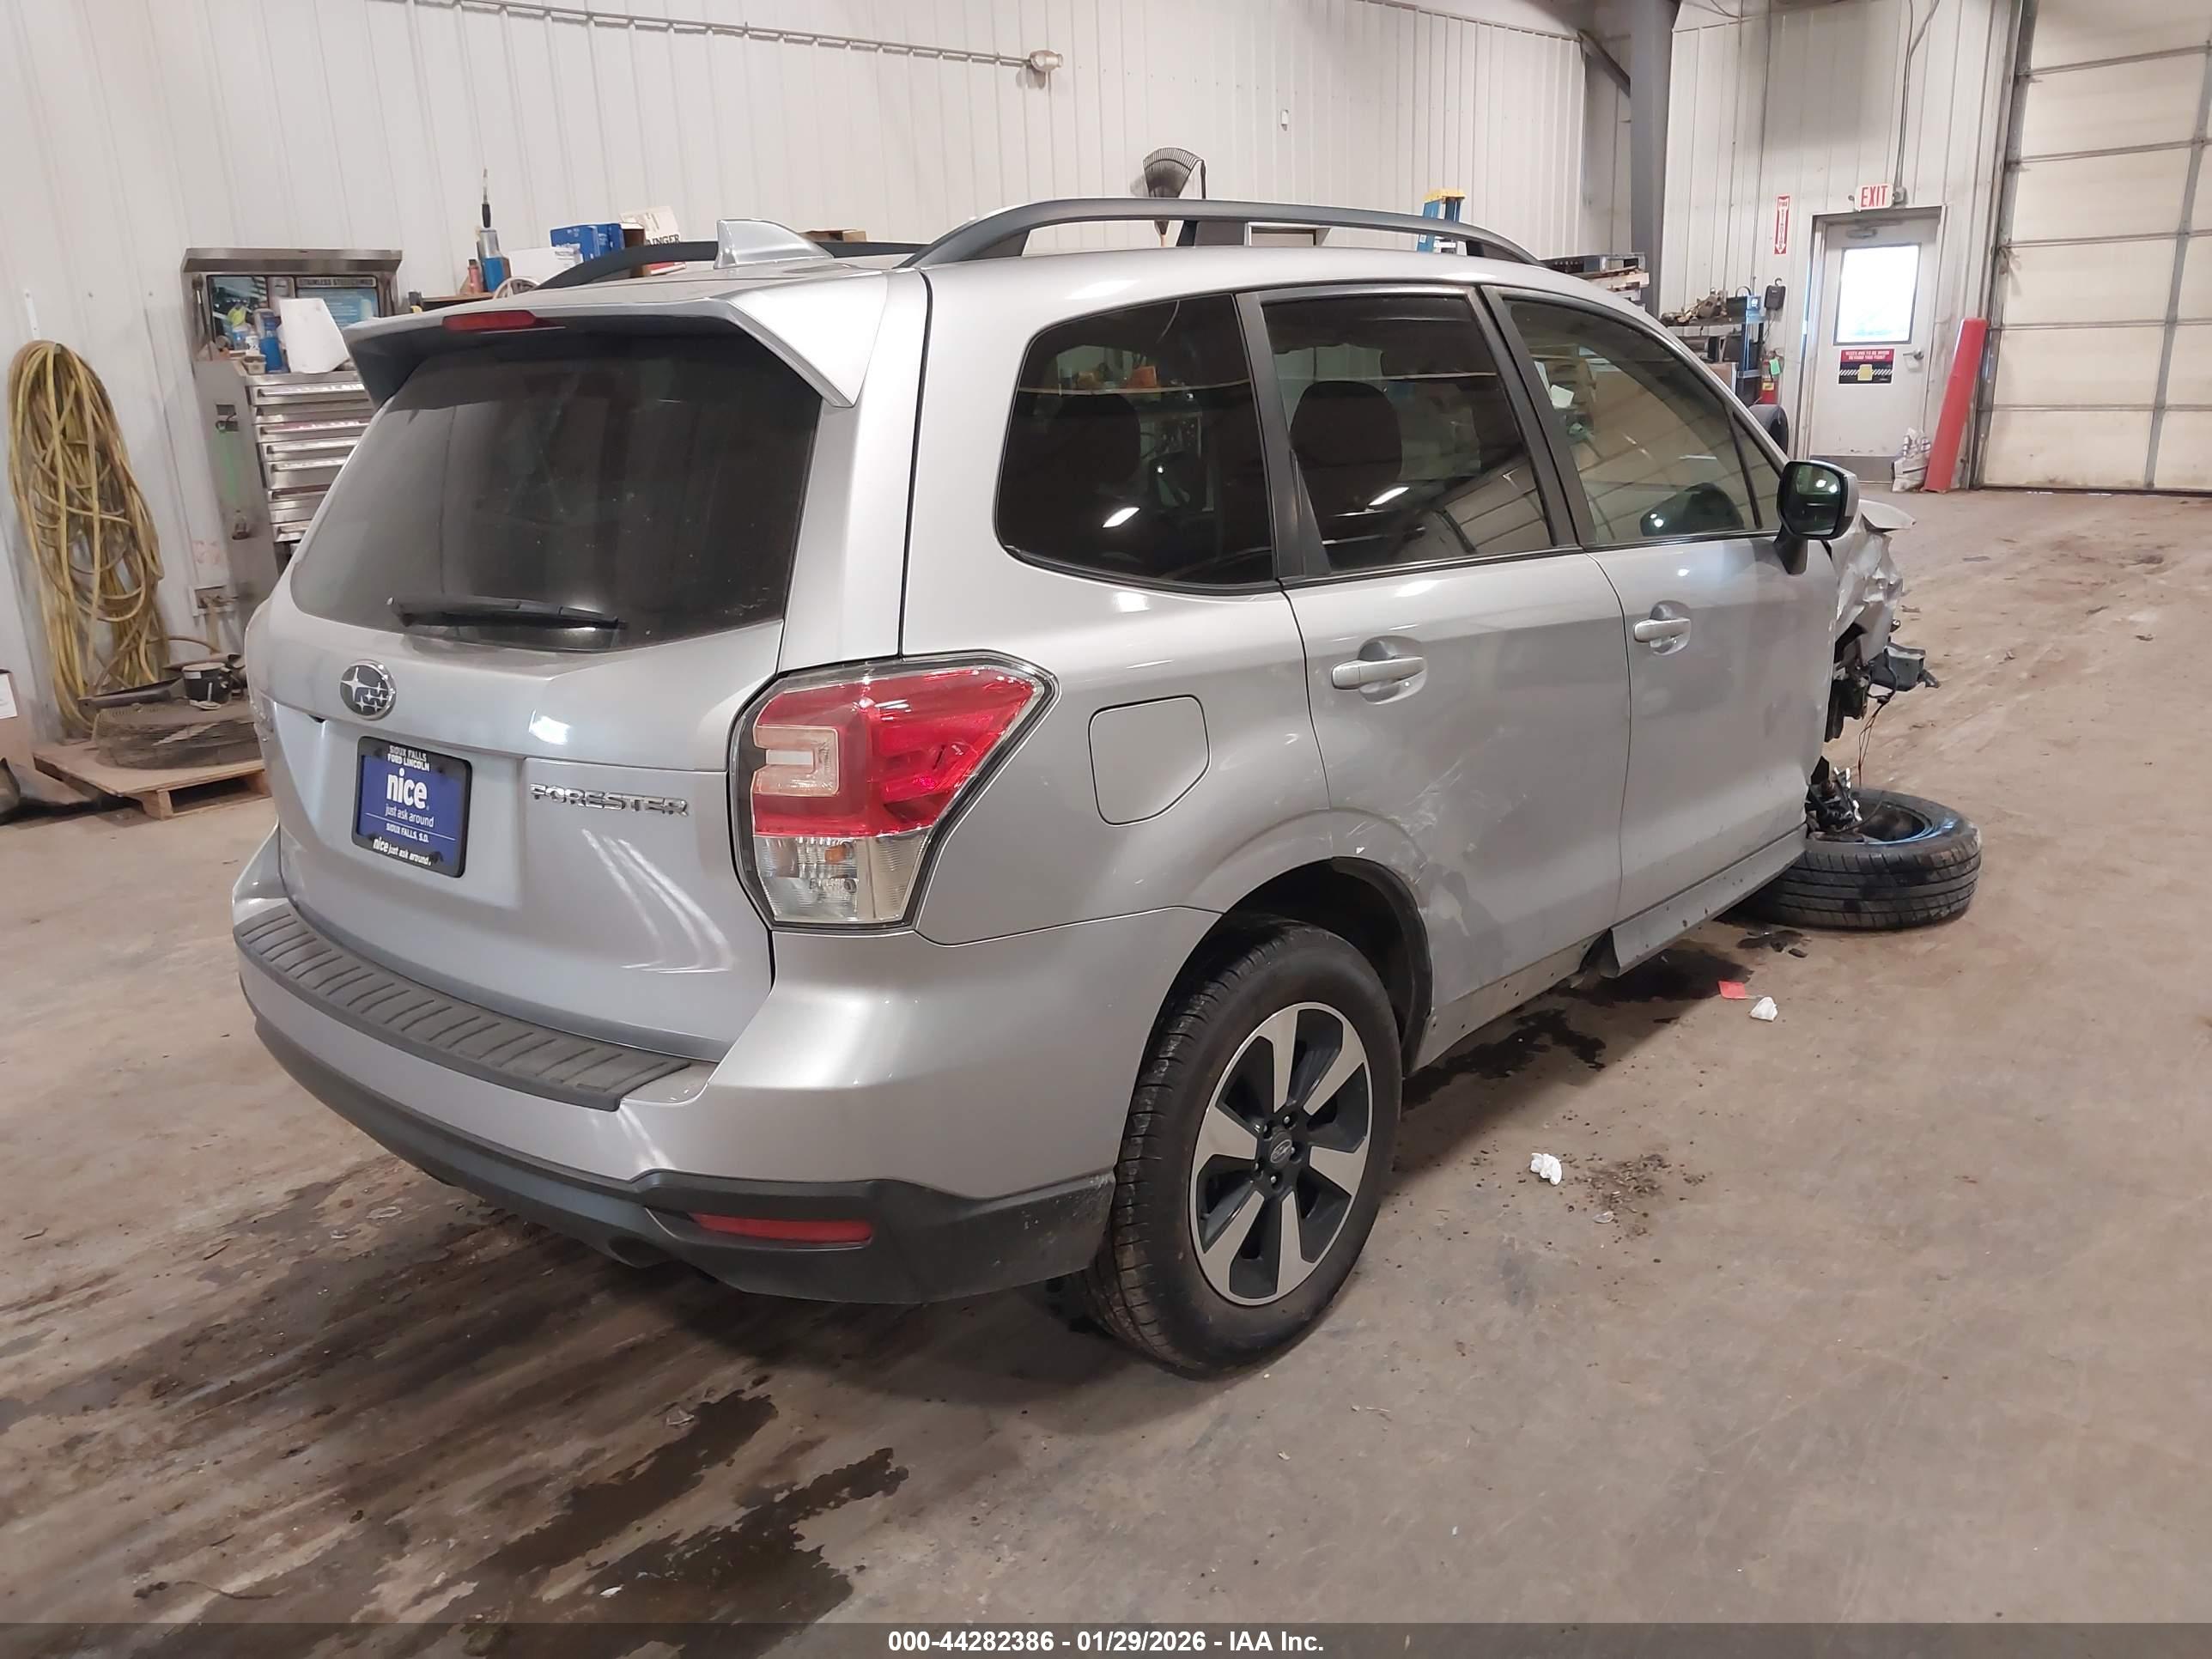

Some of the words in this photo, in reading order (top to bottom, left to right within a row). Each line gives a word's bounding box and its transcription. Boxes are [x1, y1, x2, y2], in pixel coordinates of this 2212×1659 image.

[1861, 185, 1888, 208] EXIT
[387, 753, 403, 765] FORD
[404, 757, 430, 772] LINCOLN
[389, 744, 406, 757] SIOUX
[407, 750, 427, 763] FALLS
[386, 768, 428, 809] nice
[530, 782, 689, 816] FORESTER
[385, 803, 397, 817] just
[398, 808, 408, 821] ask
[409, 811, 434, 828] around
[386, 823, 401, 835] SIOUX
[373, 836, 389, 853] nice
[387, 843, 399, 855] just
[398, 848, 409, 860] ask
